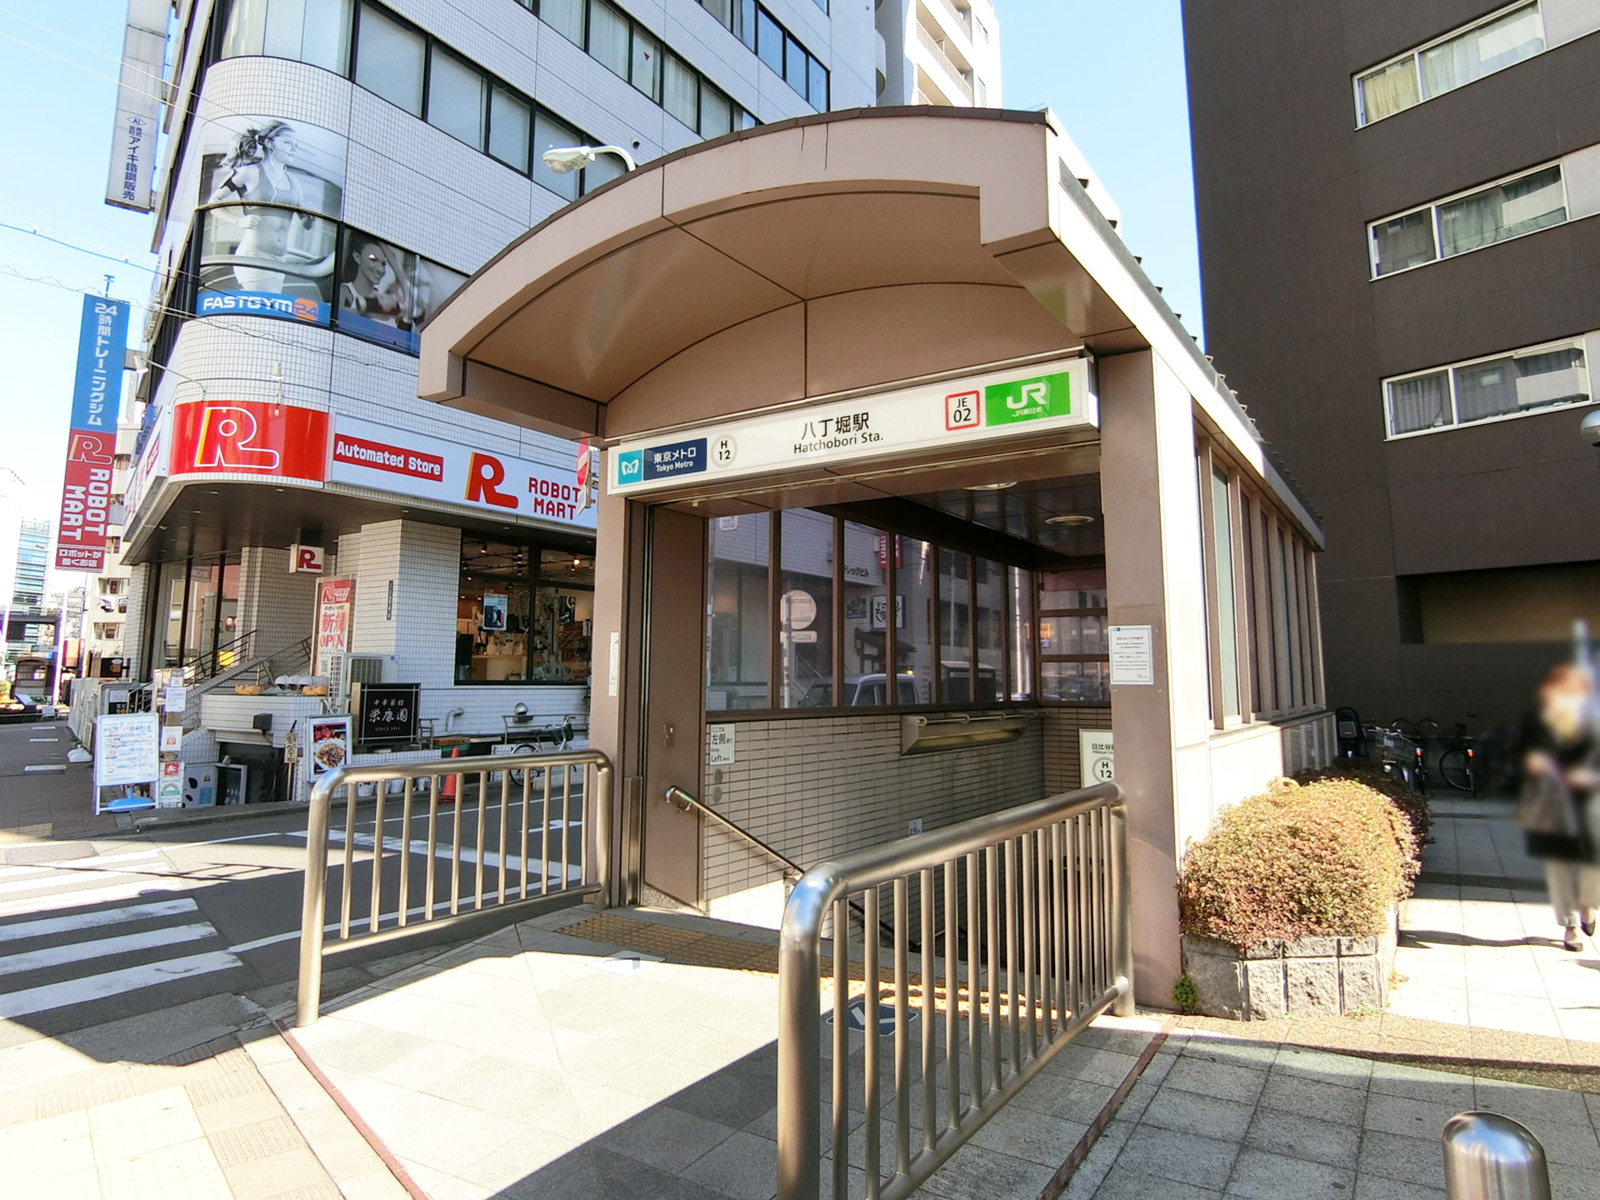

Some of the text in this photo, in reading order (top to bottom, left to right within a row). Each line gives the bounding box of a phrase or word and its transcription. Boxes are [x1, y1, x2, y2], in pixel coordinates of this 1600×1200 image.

[87, 302, 118, 426] 24時間トレーニングジム
[956, 397, 968, 408] JE
[1006, 382, 1047, 409] JR
[953, 408, 972, 423] 02
[801, 412, 869, 440] 八丁堀駅
[194, 406, 279, 469] R
[720, 440, 728, 449] H
[793, 432, 884, 454] Hatchobori Sta.
[336, 440, 441, 475] Automated Store
[653, 447, 696, 464] 東京メトロ
[719, 450, 731, 461] 12
[656, 460, 694, 473] Tokyo Metro
[464, 452, 519, 509] R
[528, 477, 581, 502] ROBOT
[84, 468, 110, 536] ROBOT
[533, 498, 577, 520] MART
[61, 485, 86, 541] MART
[59, 549, 102, 559] ロボットが
[320, 633, 345, 649] OPEN
[711, 754, 722, 762] Left
[1102, 761, 1109, 769] H
[1100, 769, 1112, 778] 12
